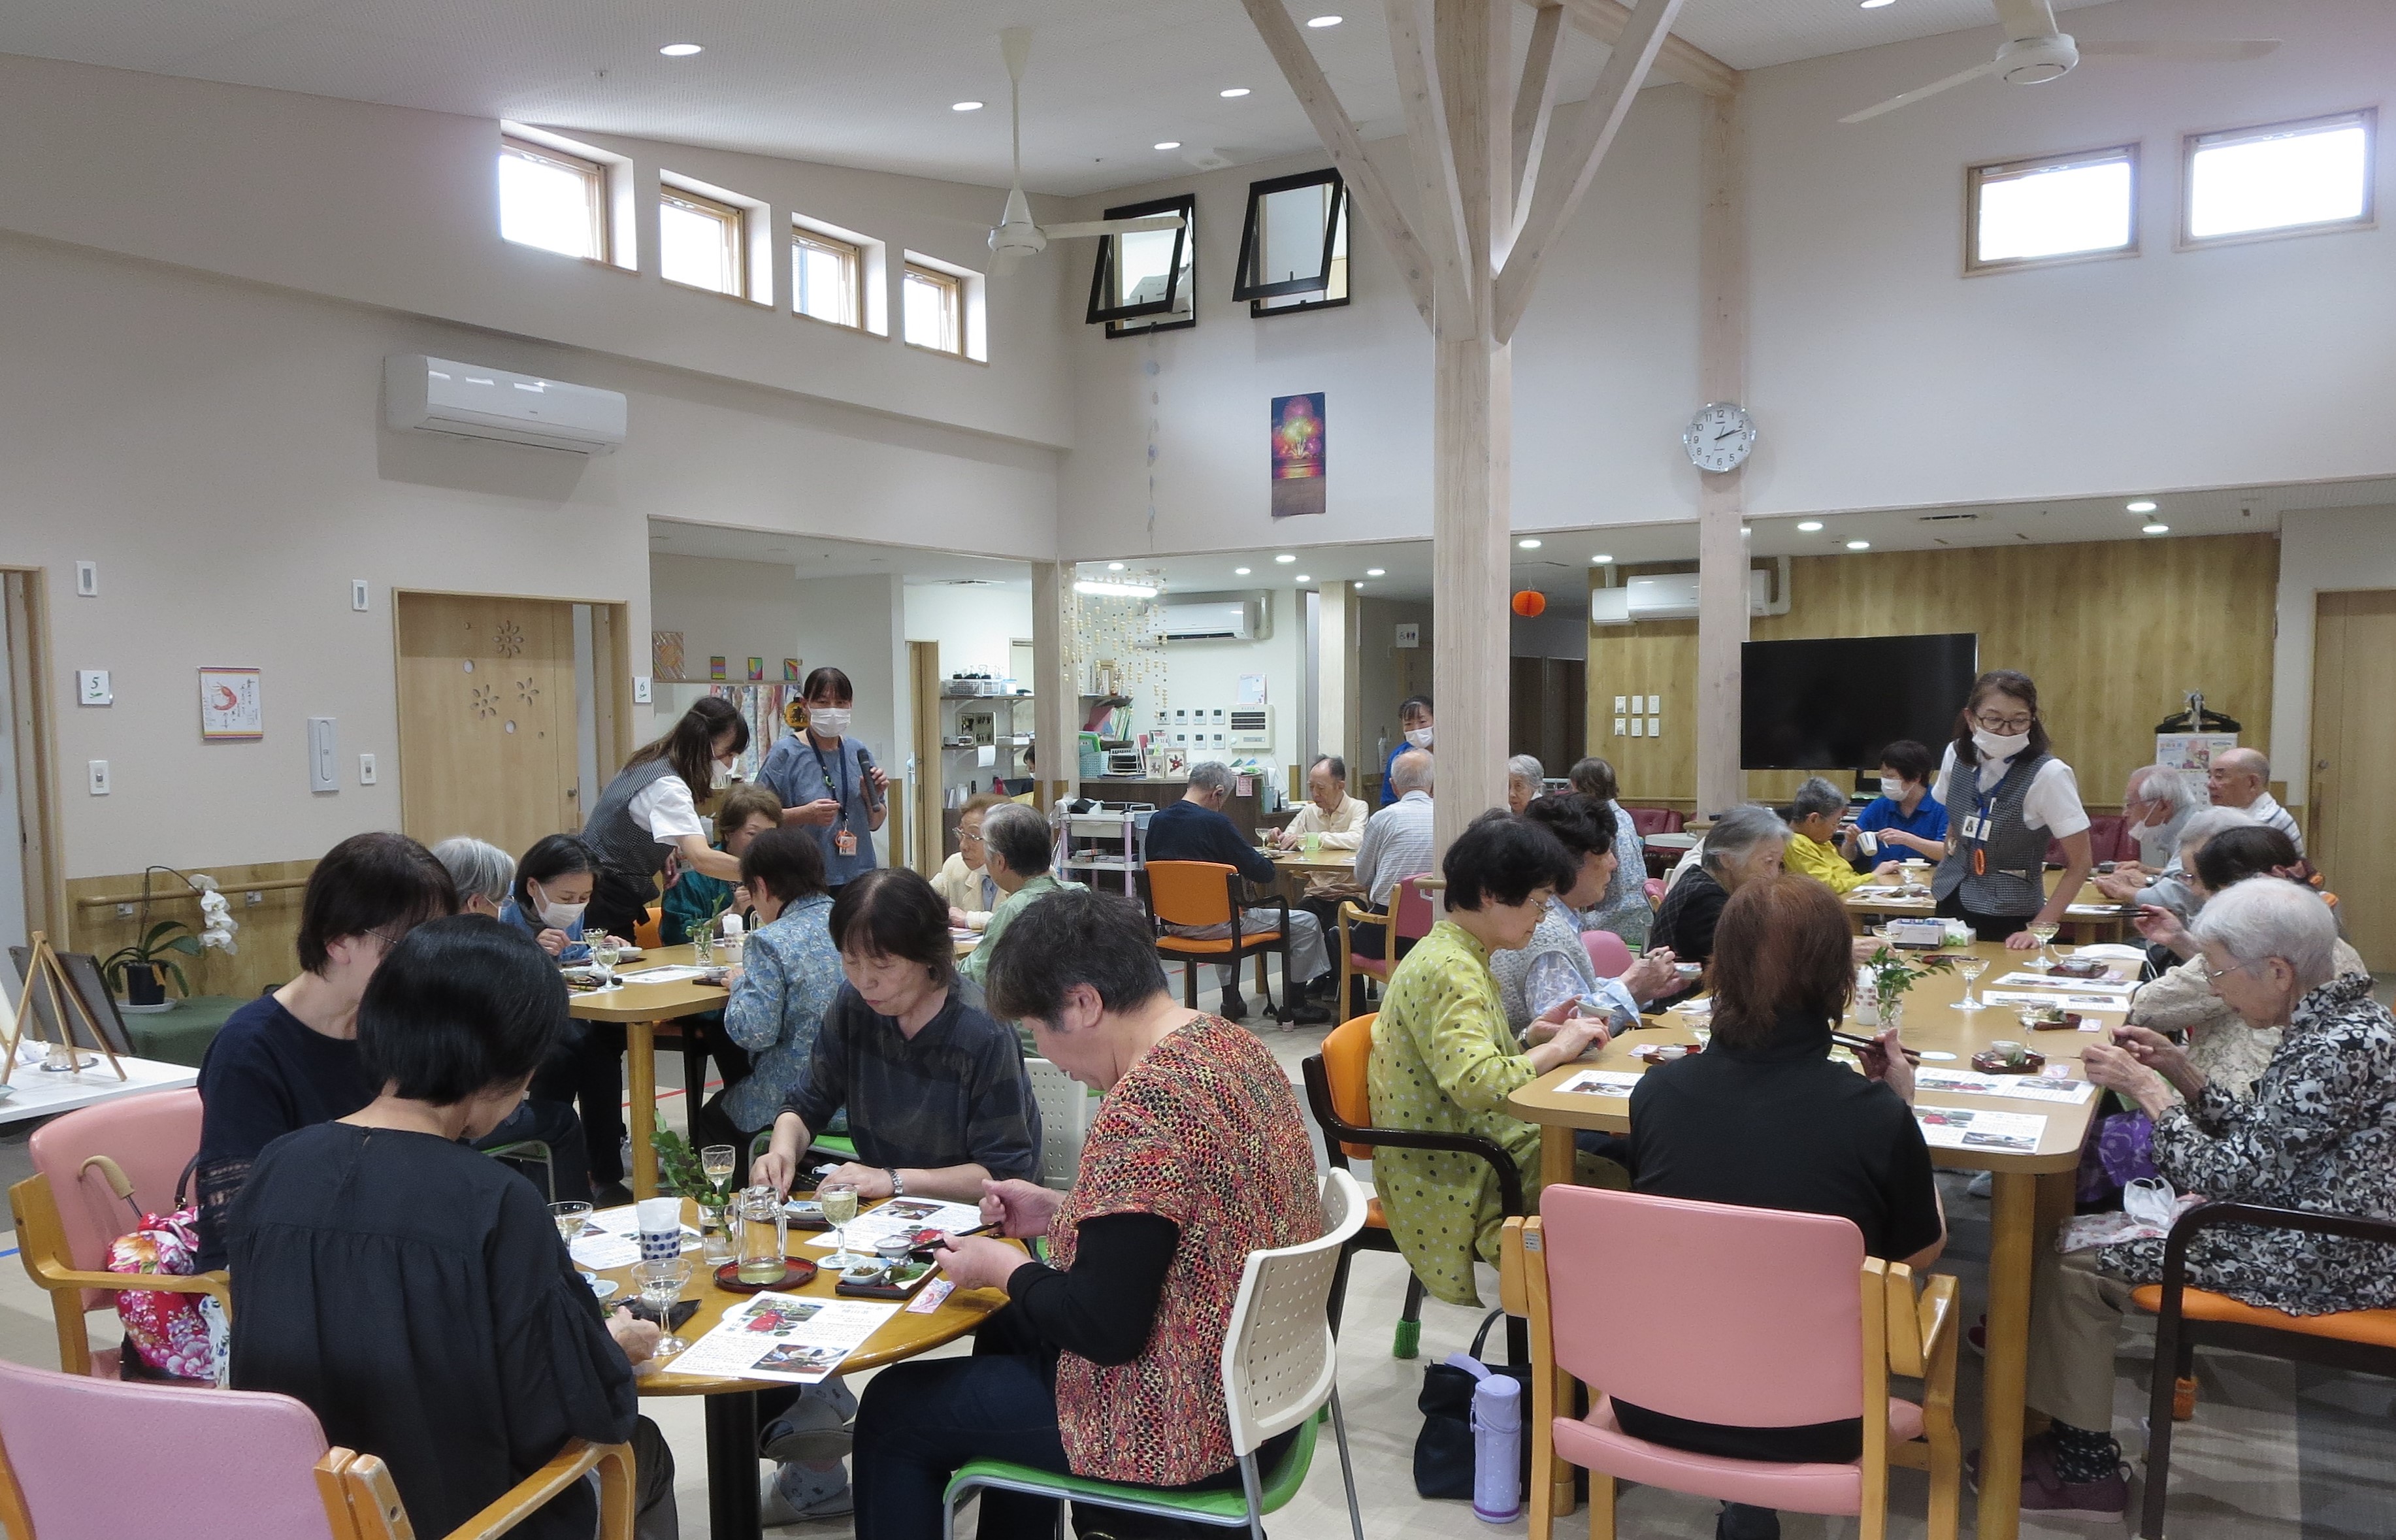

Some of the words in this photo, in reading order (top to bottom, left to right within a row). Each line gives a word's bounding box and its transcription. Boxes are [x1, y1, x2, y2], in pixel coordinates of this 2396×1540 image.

[1706, 413, 1712, 422] 11
[1716, 410, 1724, 418] 12
[1738, 419, 1744, 428] 2
[1694, 435, 1699, 444] 9
[1741, 432, 1747, 440] 3
[1696, 447, 1702, 455] 8
[1705, 455, 1711, 463] 7
[1716, 457, 1722, 466] 6
[1729, 453, 1735, 462] 5
[90, 676, 100, 689] 5
[640, 681, 645, 691] 6
